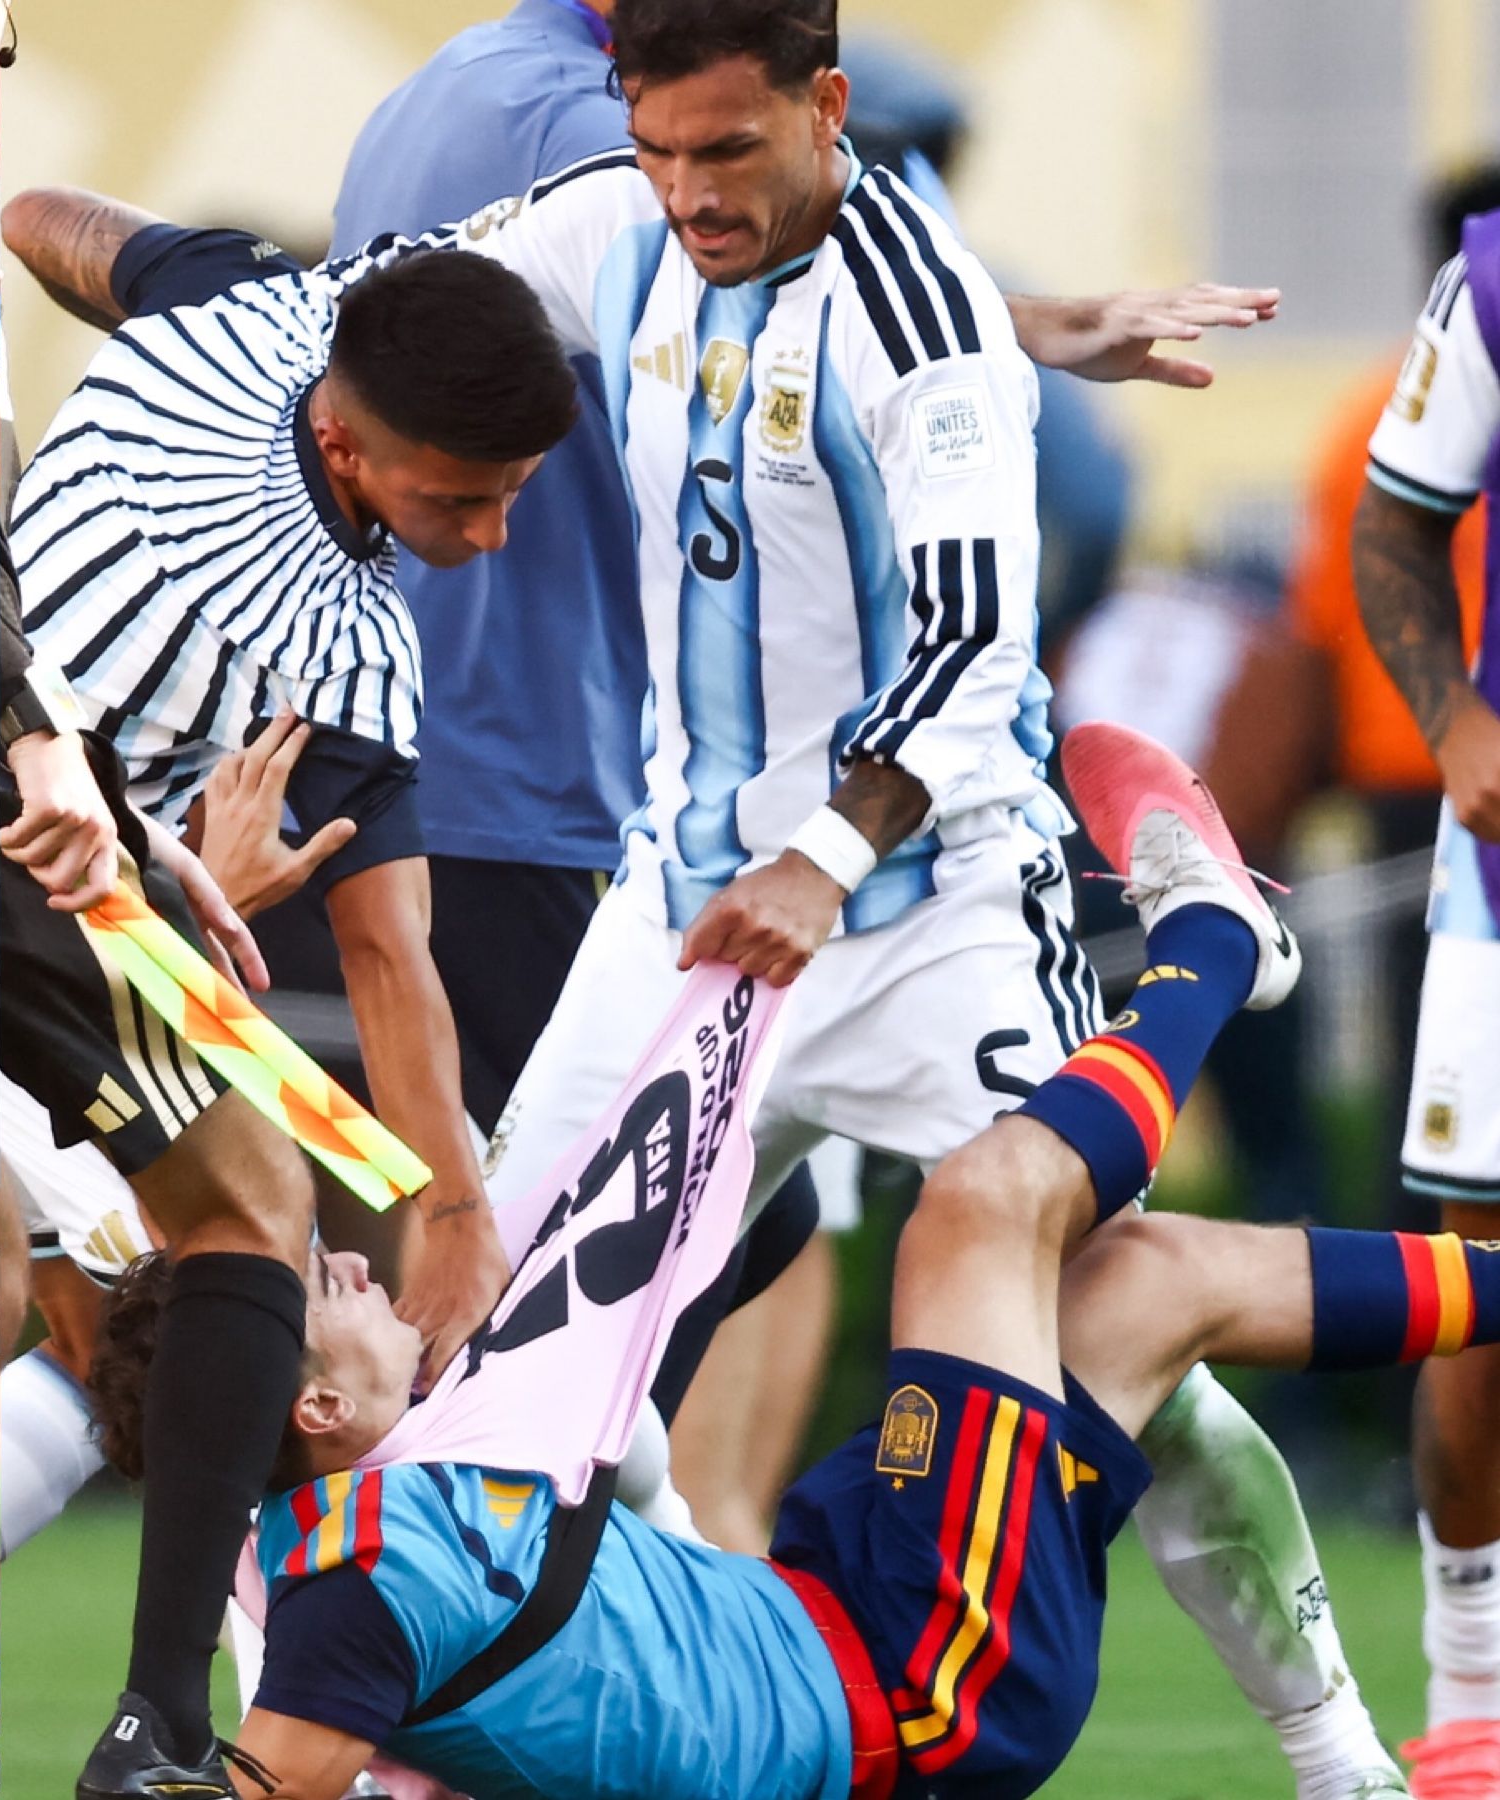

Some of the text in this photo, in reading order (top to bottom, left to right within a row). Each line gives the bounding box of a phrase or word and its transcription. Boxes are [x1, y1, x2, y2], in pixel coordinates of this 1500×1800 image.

[924, 397, 977, 415] FOOTBALL
[927, 411, 979, 437] UNITES
[696, 1023, 720, 1081] CUP
[645, 1106, 672, 1212] FIFA
